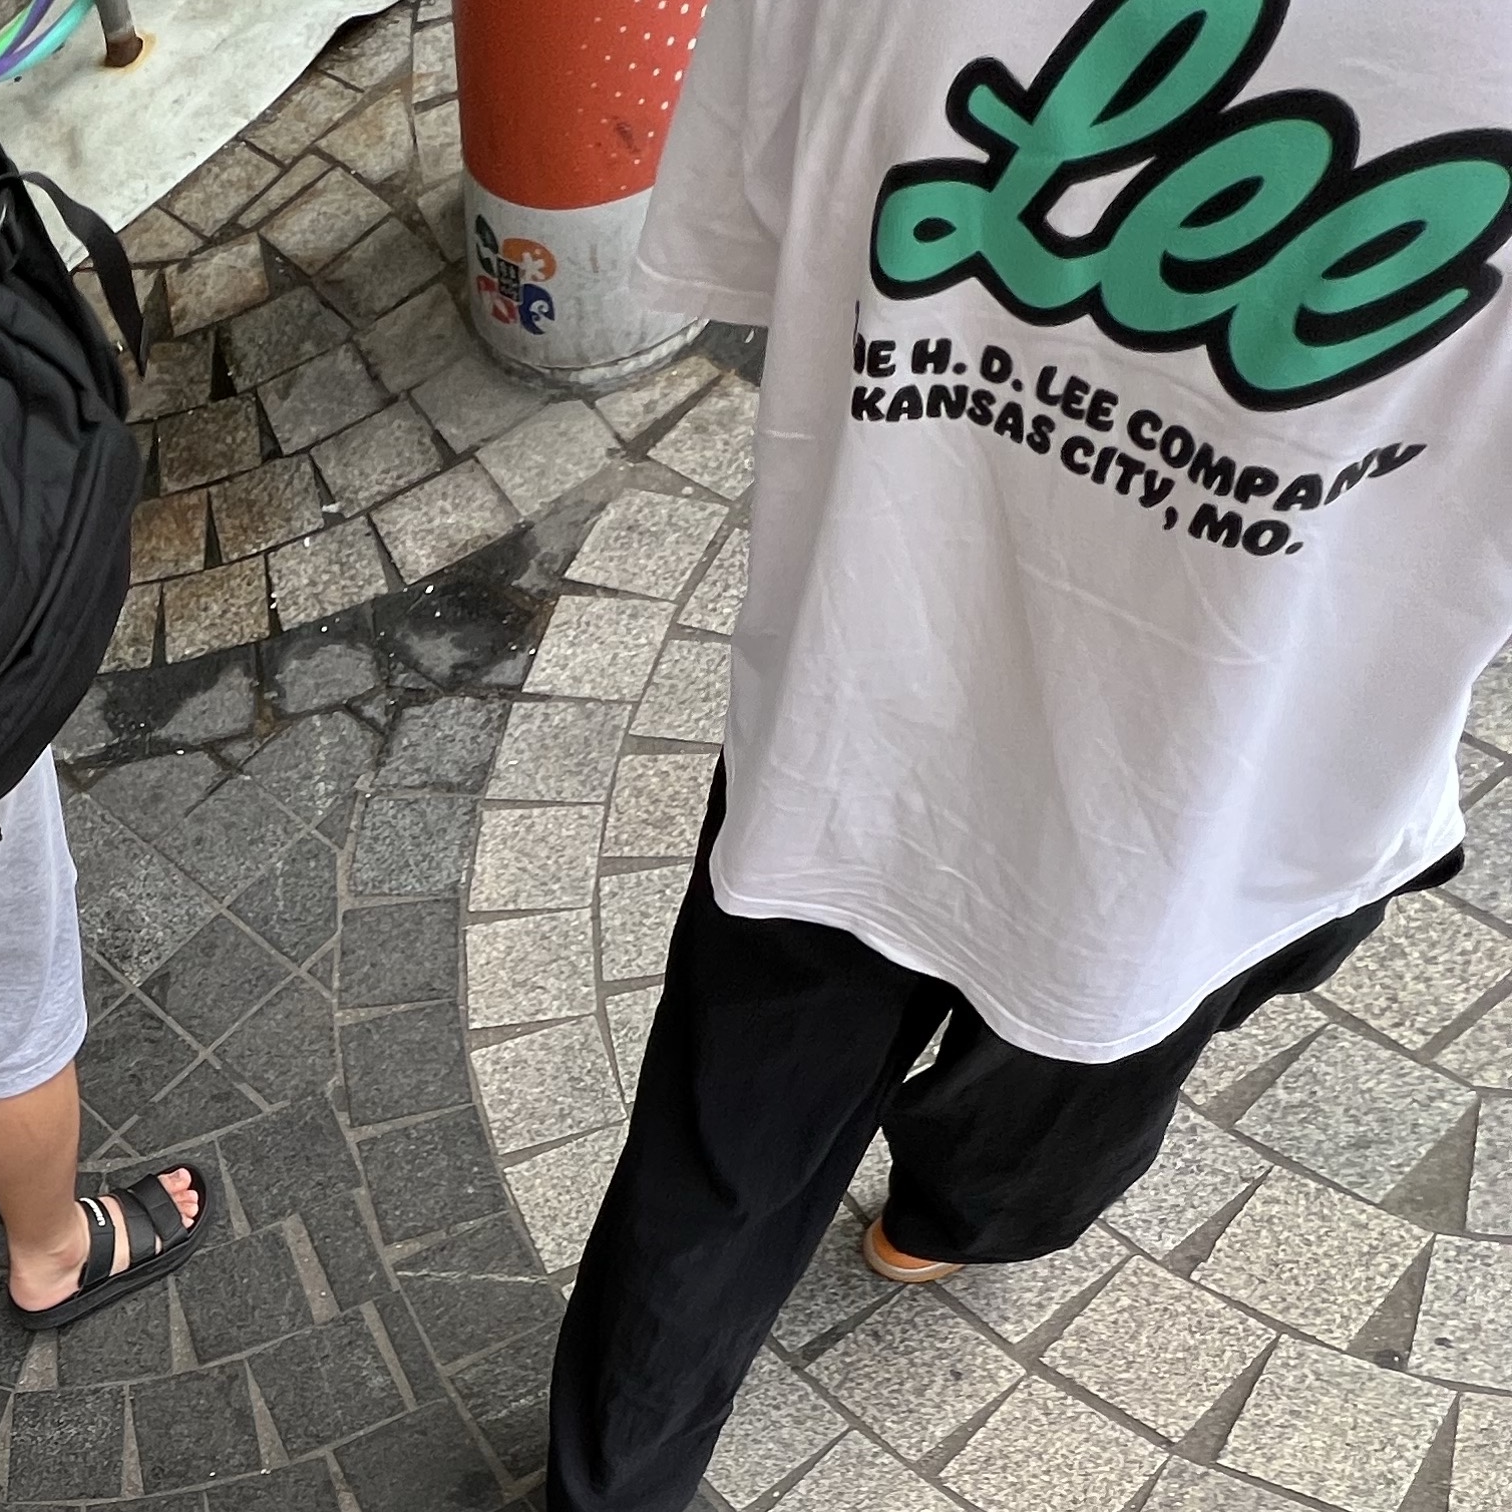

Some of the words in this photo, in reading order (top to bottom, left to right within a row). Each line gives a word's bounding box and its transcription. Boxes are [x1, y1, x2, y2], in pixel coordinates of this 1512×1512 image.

[869, 0, 1512, 412] Lee
[850, 384, 1056, 456] KANSAS
[1187, 502, 1303, 557] MO.
[912, 339, 966, 375] H.
[979, 345, 1024, 392] D.
[1035, 366, 1119, 433] LEE
[1126, 409, 1427, 512] COMPANY
